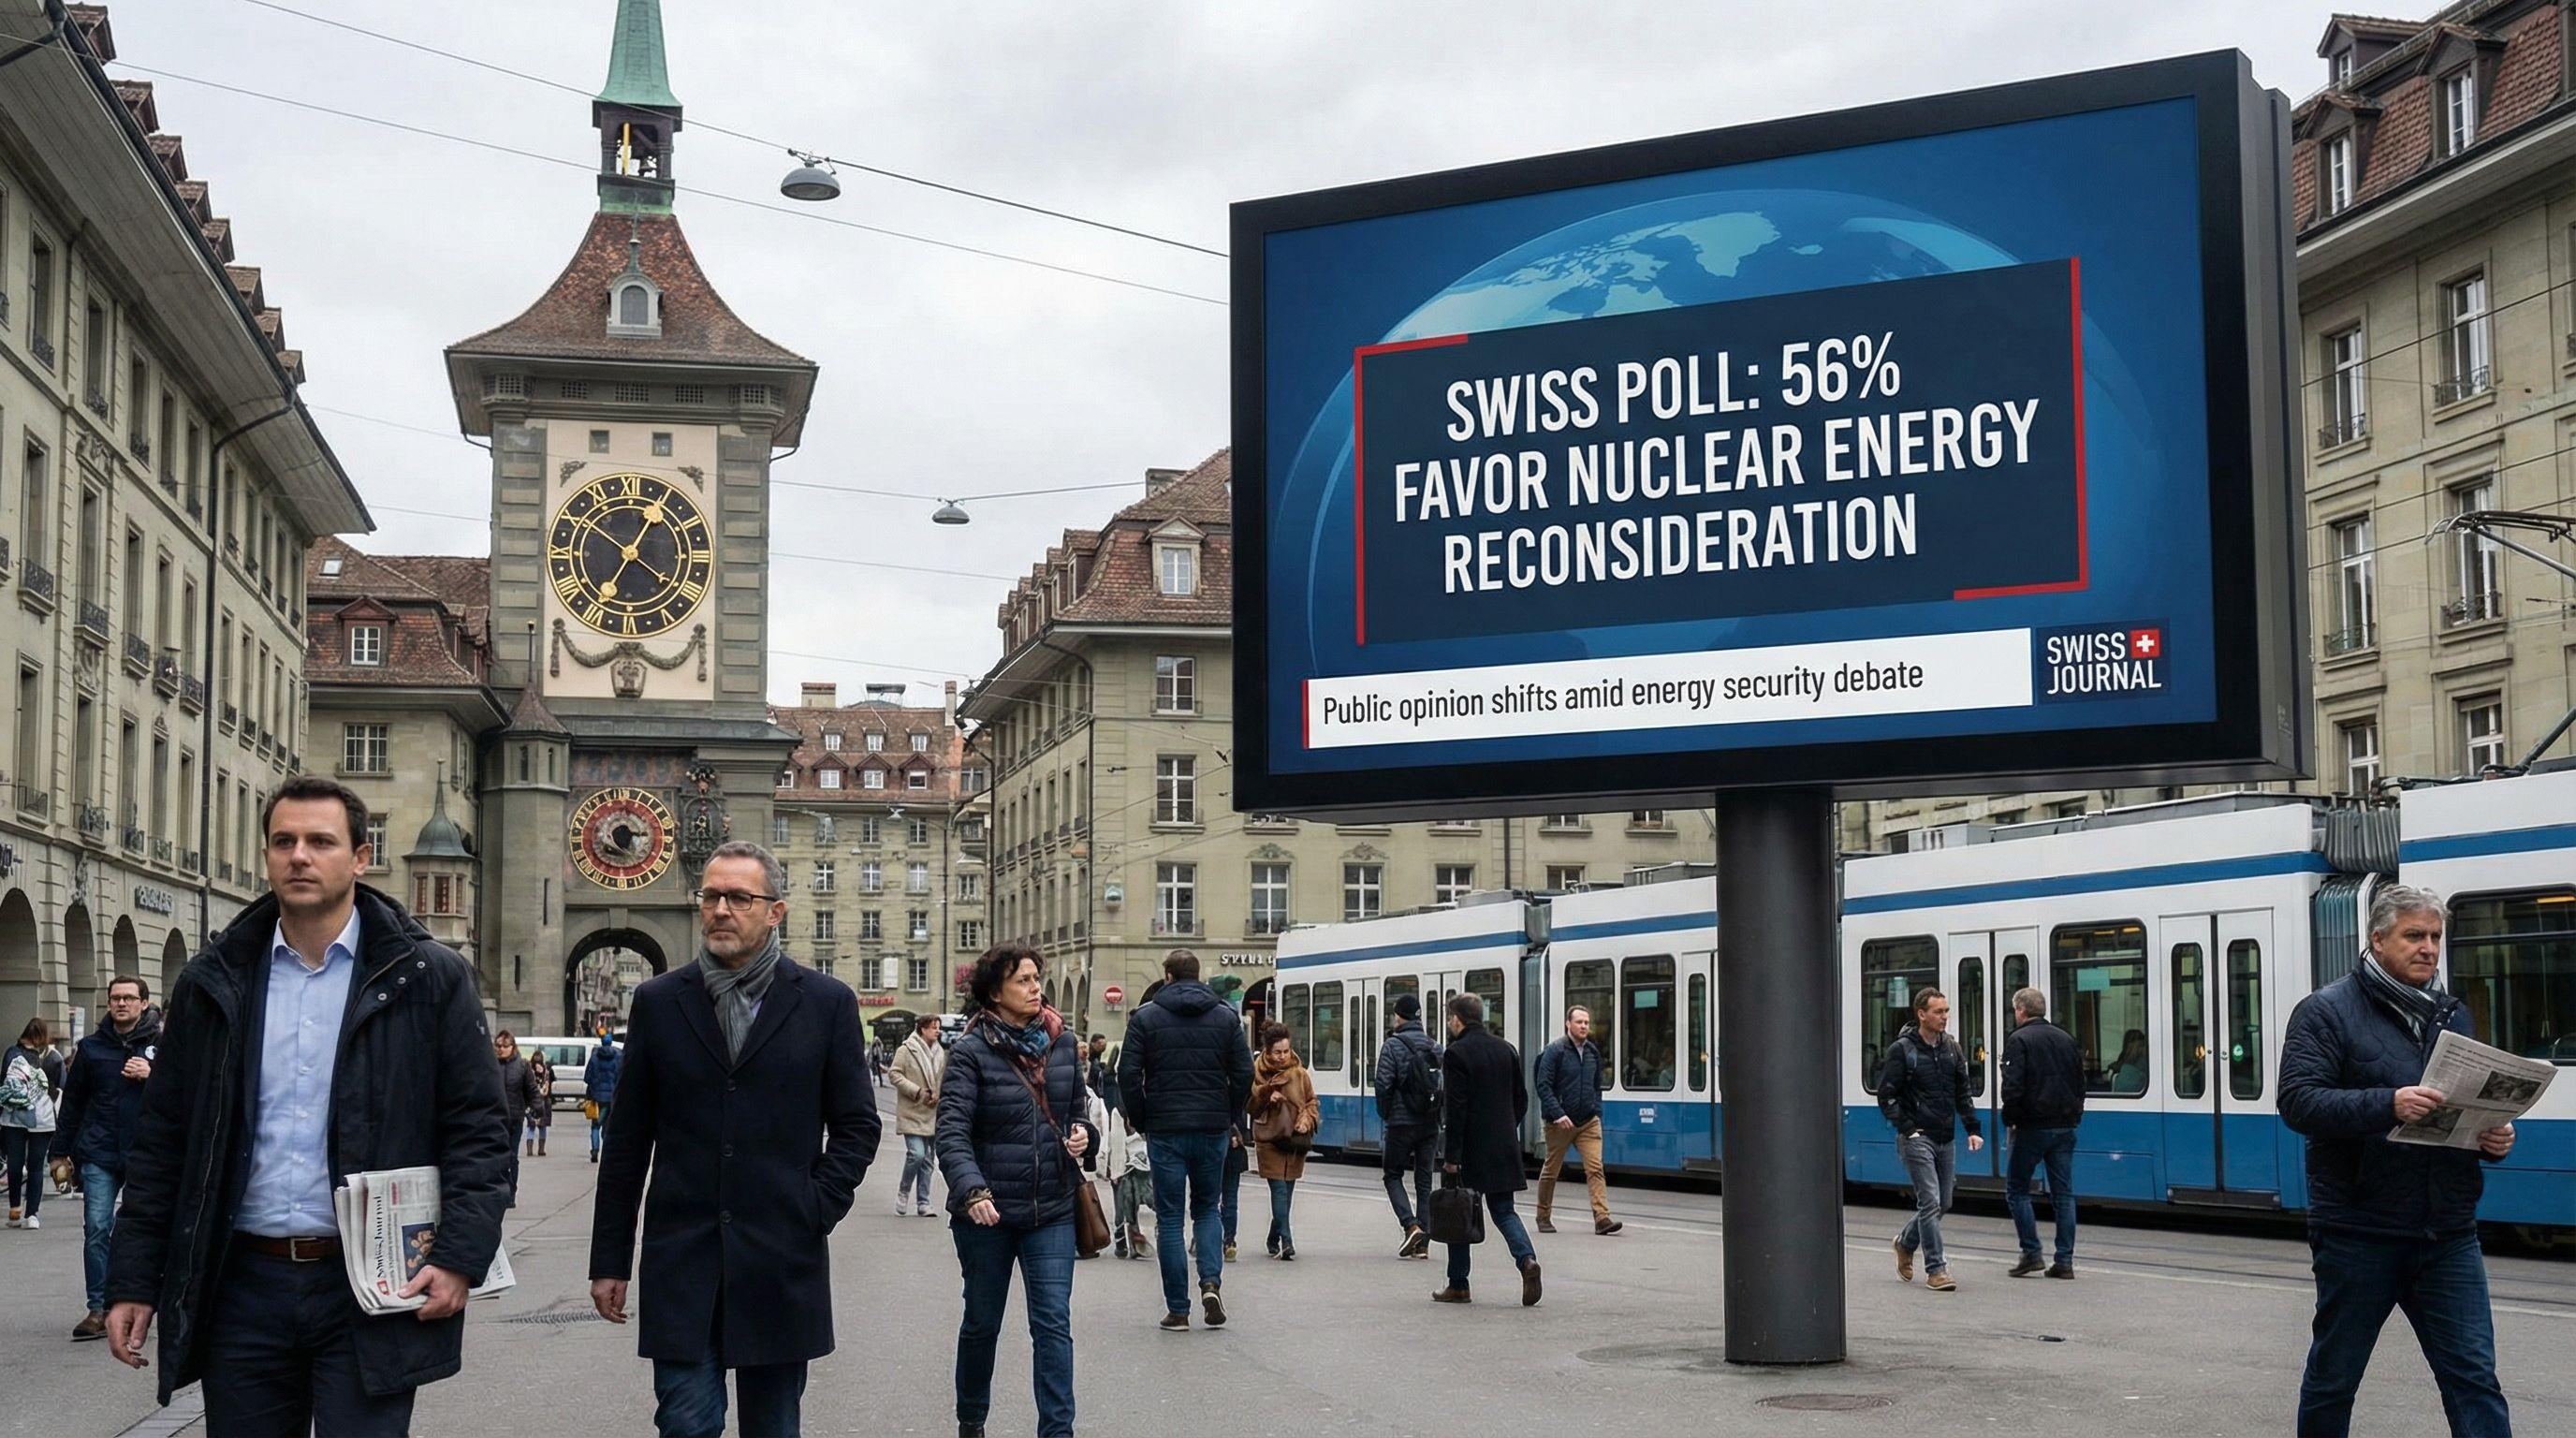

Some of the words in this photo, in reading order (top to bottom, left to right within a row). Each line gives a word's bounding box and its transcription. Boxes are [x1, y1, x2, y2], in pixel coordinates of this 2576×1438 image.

[1446, 366, 1600, 443] SWISS
[1617, 351, 1761, 424] POLL:
[1781, 331, 1901, 406] 56%
[620, 477, 641, 497] XII
[1396, 450, 1550, 522] FAVOR
[1568, 424, 1805, 506] NUCLEAR
[1824, 398, 2040, 481] ENERGY
[1444, 492, 1916, 594] RECONSIDERATION
[2044, 659, 2163, 697] JOURNAL
[2046, 632, 2127, 665] SWISS
[1323, 694, 1393, 726] Public
[1399, 690, 1485, 728] opinion
[1491, 682, 1558, 715] shifts
[1565, 678, 1624, 711] amid
[1632, 680, 1717, 713] energy
[1723, 666, 1826, 704] security
[1834, 661, 1925, 694] debate
